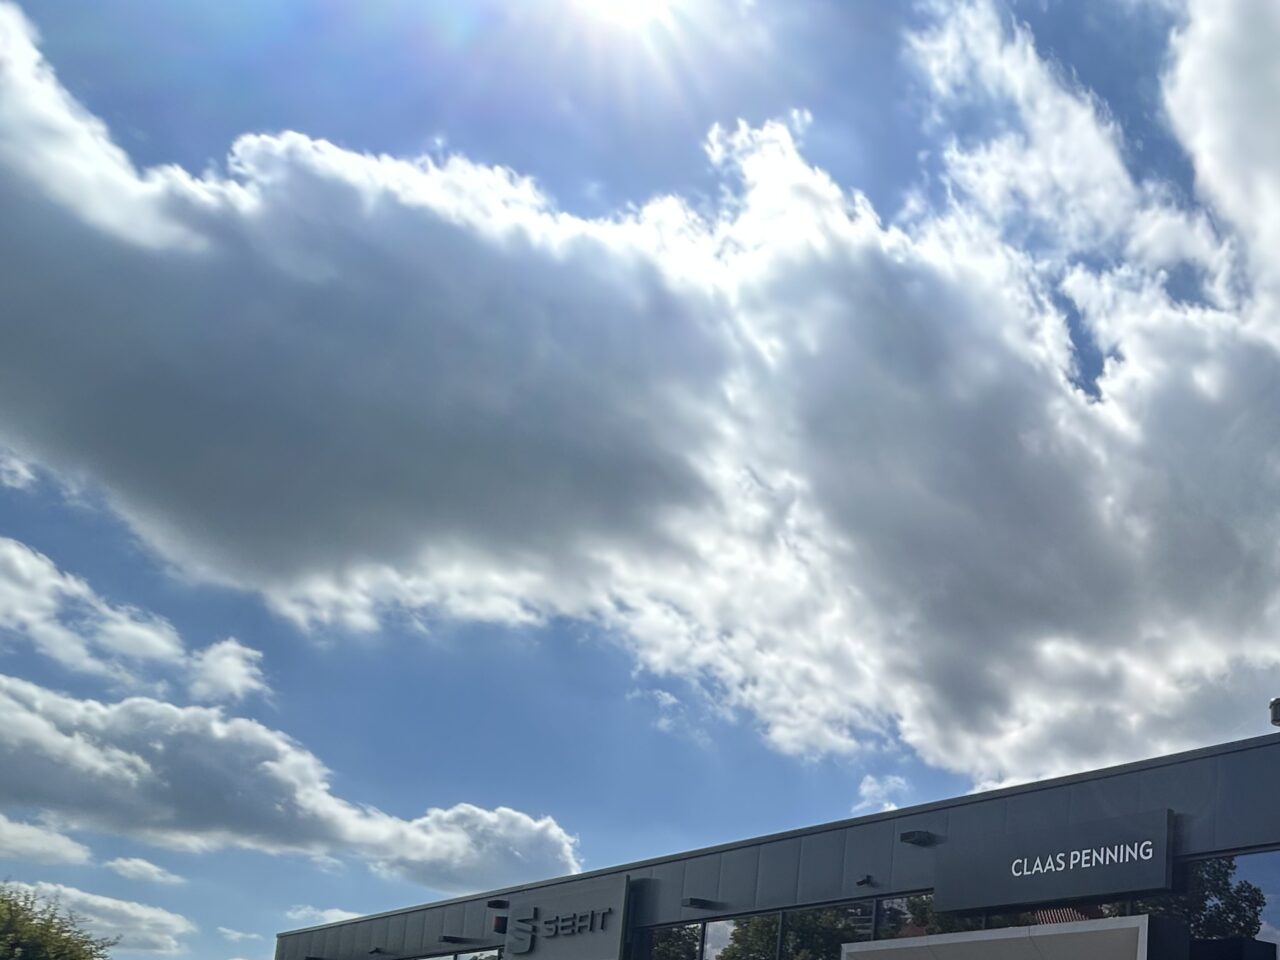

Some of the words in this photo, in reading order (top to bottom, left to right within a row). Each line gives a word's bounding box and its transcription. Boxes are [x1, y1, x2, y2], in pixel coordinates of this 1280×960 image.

[1011, 853, 1066, 877] CLAAS
[1069, 841, 1153, 870] PENNING
[542, 907, 612, 938] SEAT
